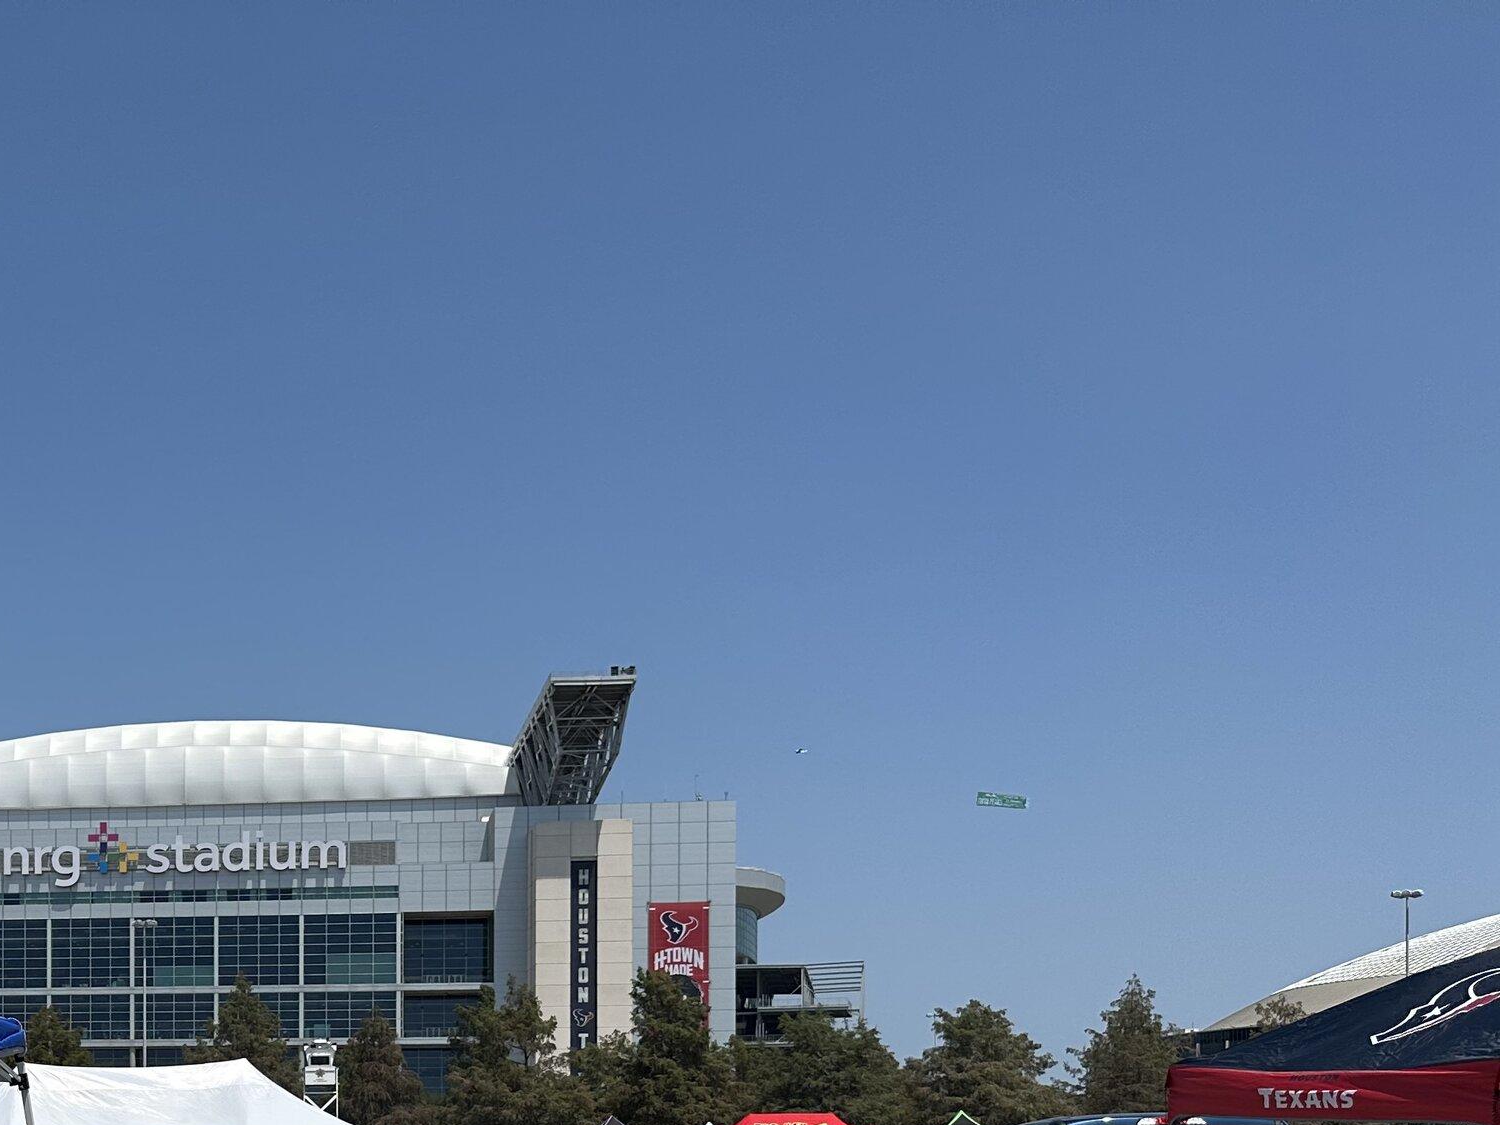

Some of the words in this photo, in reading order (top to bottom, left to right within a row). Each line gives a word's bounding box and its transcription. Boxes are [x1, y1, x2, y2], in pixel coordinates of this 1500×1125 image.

[3, 845, 81, 887] nrg
[146, 829, 347, 874] stadium
[578, 868, 590, 1003] HOUSTON
[1257, 1087, 1358, 1109] TEXANS
